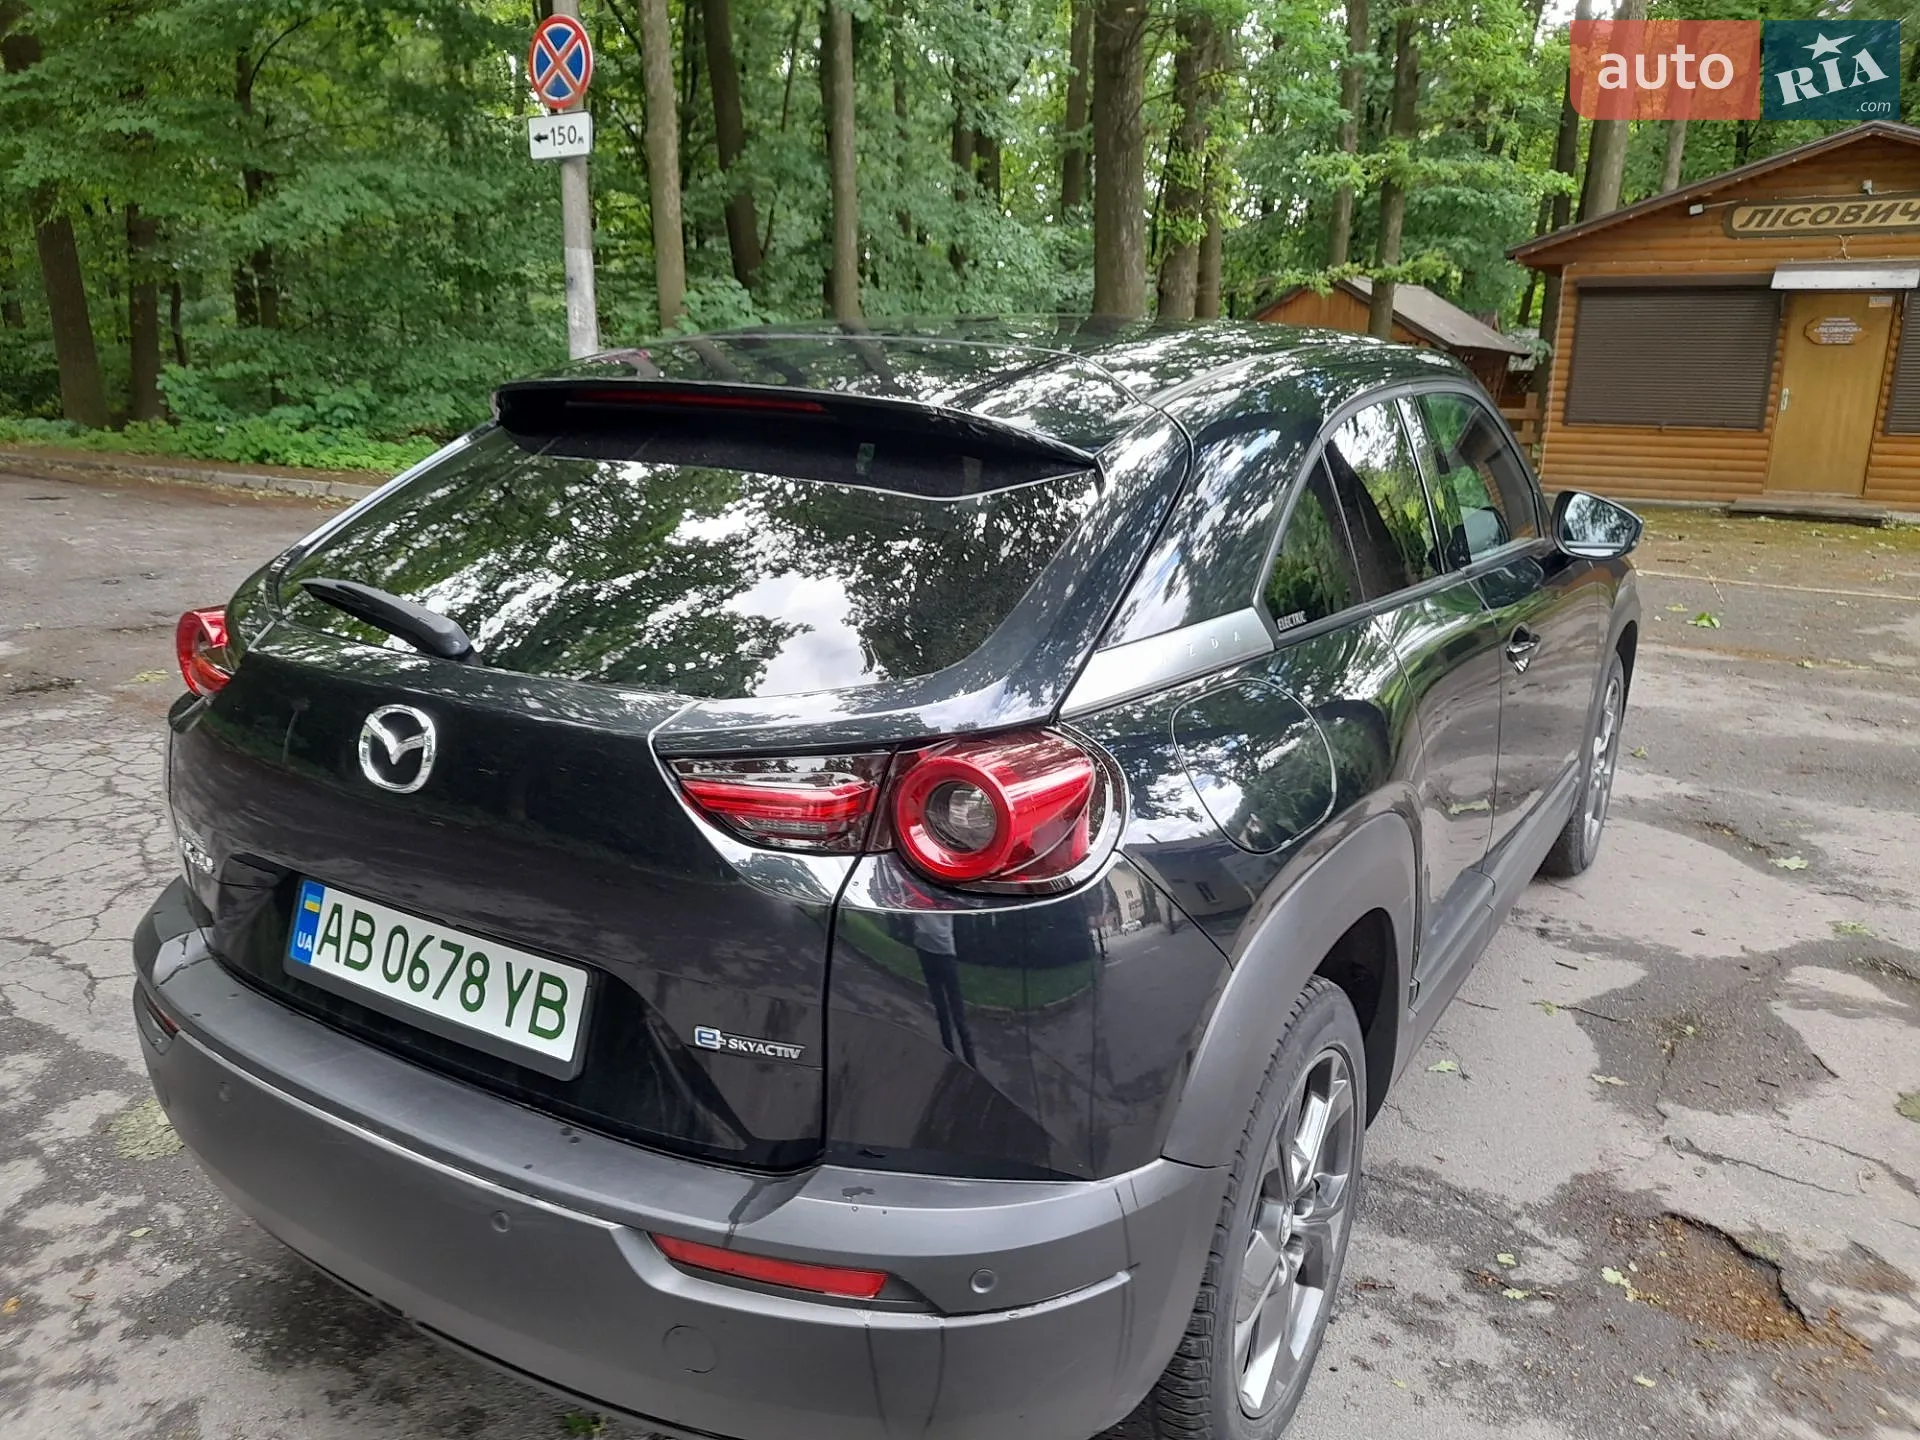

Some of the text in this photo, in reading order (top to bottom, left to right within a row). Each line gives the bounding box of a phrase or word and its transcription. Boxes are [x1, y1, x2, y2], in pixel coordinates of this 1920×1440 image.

[1277, 610, 1307, 631] ELECTRIC
[297, 931, 313, 952] UA
[316, 903, 569, 1040] AB 0678 YB
